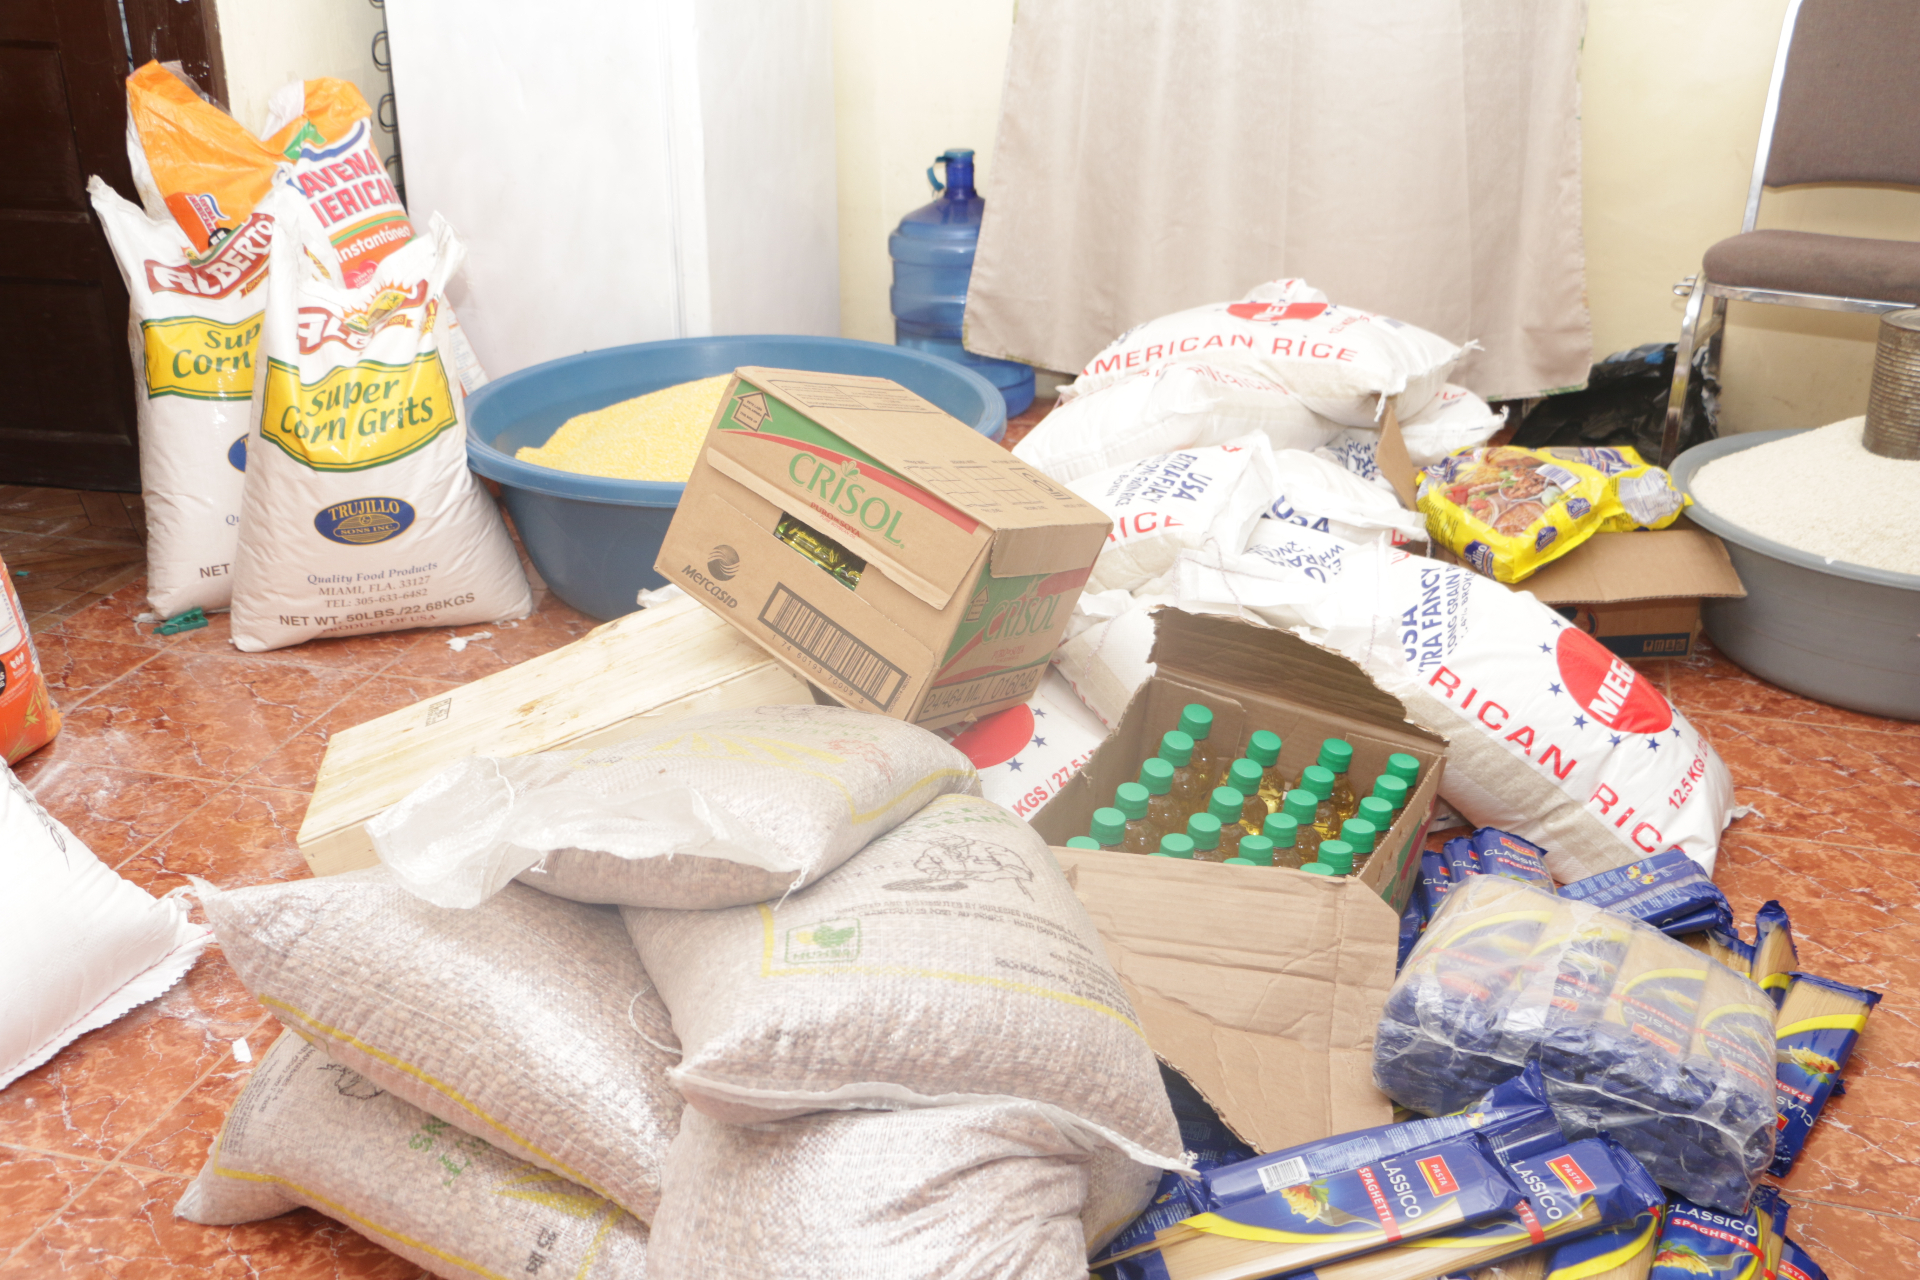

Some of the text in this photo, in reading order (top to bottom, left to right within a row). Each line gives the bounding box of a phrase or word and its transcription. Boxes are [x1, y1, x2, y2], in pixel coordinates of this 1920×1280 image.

[298, 149, 381, 199] AVENA
[310, 178, 402, 228] ERICAN
[152, 220, 273, 295] ALBERTO
[333, 225, 411, 263] Instantáneo
[204, 323, 261, 350] Sup
[1271, 337, 1358, 362] RICE
[172, 349, 252, 379] Corn
[305, 376, 399, 418] Super
[280, 395, 434, 444] Corn Grits
[789, 452, 904, 546] CRISOL
[1171, 472, 1213, 502] USA
[328, 499, 400, 521] TRUJILLO
[810, 502, 836, 520] PURO
[839, 519, 861, 537] SOYA
[341, 523, 396, 535] SONS INC.
[199, 563, 230, 578] NET
[307, 561, 438, 585] Quality Food Products
[318, 575, 431, 597] MIAMI, FLA. 33127
[1461, 569, 1476, 607] BROKE
[325, 588, 428, 608] TEL: 305-633-6482
[1421, 567, 1442, 630] FANCY
[1445, 573, 1460, 615] GRAIN
[279, 614, 309, 626] NET
[314, 615, 342, 626] WT.
[322, 613, 437, 633] PRODUCT OF USA
[982, 594, 1061, 644] CRISOL
[781, 641, 792, 652] 74
[797, 652, 822, 674] 60193
[827, 675, 854, 697] 70009
[1418, 632, 1442, 673] TRA
[923, 687, 963, 714] 24/464
[991, 668, 1038, 700] 016049
[1588, 658, 1636, 724] MEG
[1428, 665, 1685, 854] RICAN RIC
[1011, 786, 1049, 818] KGS
[1051, 759, 1083, 788] 275
[1668, 777, 1693, 809] 12.5
[1623, 1006, 1685, 1039] ASSICO
[1706, 1040, 1768, 1076] ASSICO
[1776, 1080, 1812, 1103] SPAGH
[1776, 1096, 1814, 1127] CLAS
[1381, 1158, 1422, 1219] LASSICO
[1430, 1164, 1448, 1187] PASTA
[1510, 1160, 1563, 1220] LASSICO
[1561, 1163, 1584, 1185] PASTA
[1359, 1167, 1392, 1222] SPAGHETTI
[1673, 1218, 1749, 1249] SPAGHETTI
[1779, 1264, 1805, 1280] ASTA
